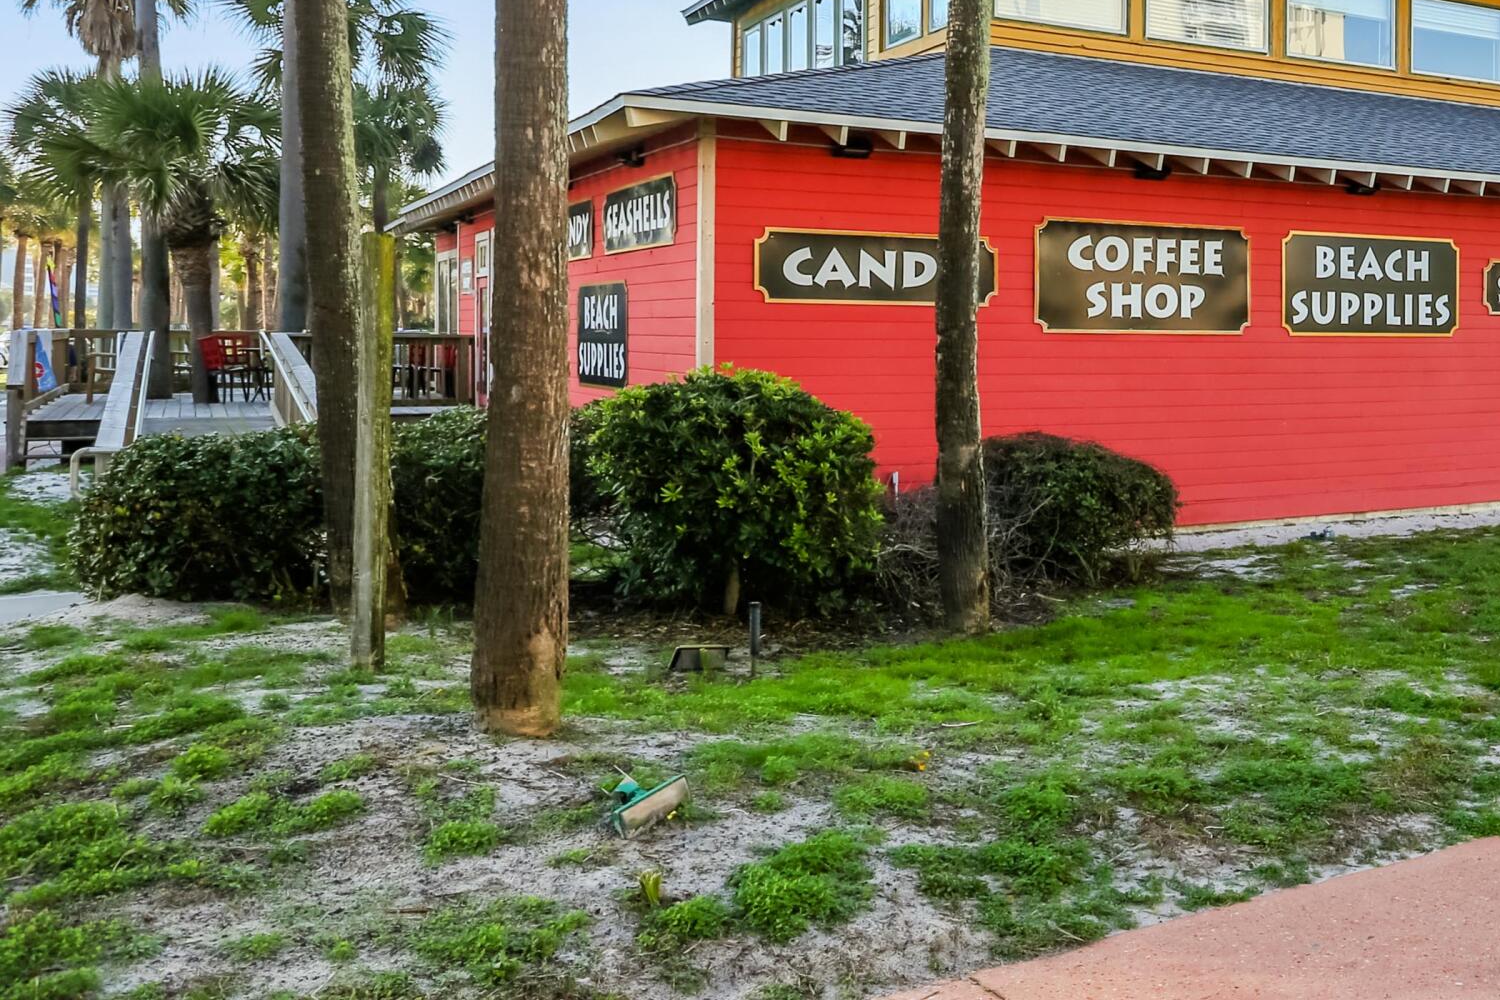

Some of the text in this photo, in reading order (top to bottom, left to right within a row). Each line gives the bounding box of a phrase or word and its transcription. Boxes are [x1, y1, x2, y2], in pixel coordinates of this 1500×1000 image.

[568, 212, 589, 248] NDY
[606, 190, 670, 239] SEASHELLS
[782, 247, 938, 290] CAND
[1067, 235, 1225, 277] COFFEE
[1315, 245, 1431, 282] BEACH
[584, 294, 618, 330] BEACH
[1086, 281, 1206, 319] SHOP
[1291, 290, 1450, 327] SUPPLIES
[579, 341, 625, 380] SUPPLIES
